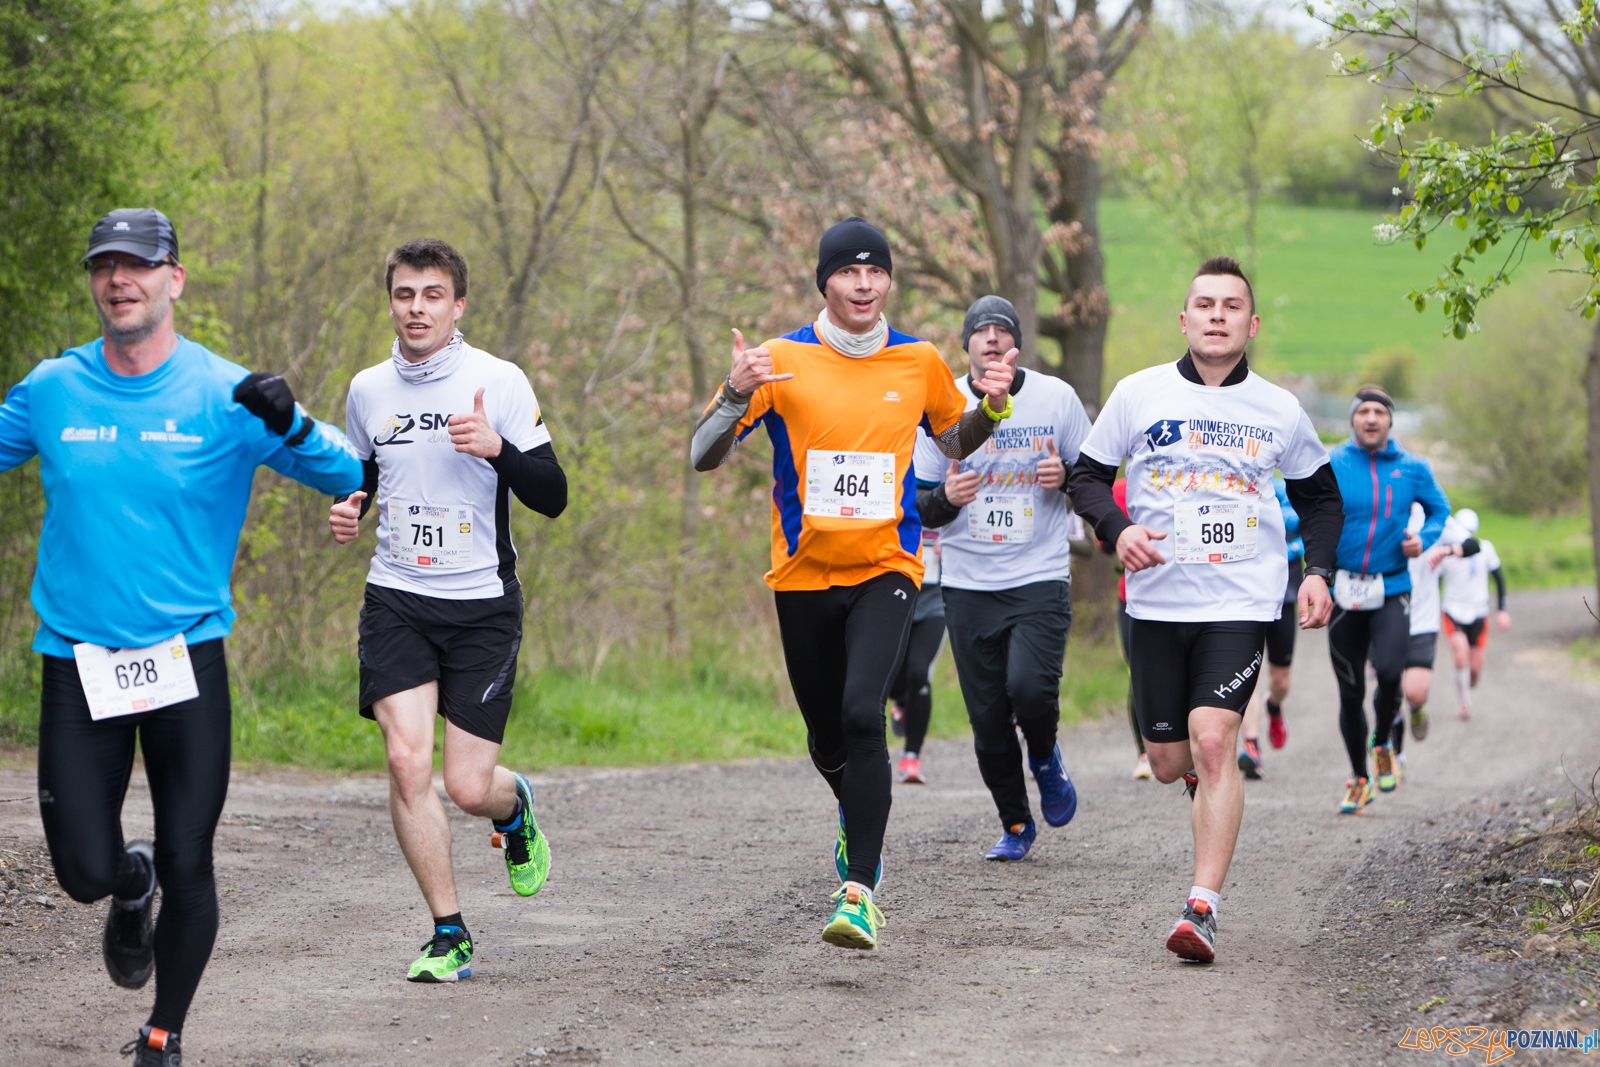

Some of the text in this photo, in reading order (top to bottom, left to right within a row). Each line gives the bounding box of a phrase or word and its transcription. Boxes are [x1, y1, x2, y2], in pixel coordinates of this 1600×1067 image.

[855, 251, 871, 260] 4F
[419, 412, 455, 430] SM
[427, 431, 453, 444] RUNN
[989, 425, 1055, 440] NIWERSYTECKA
[1189, 419, 1273, 444] UNIWERSYTECKA
[984, 437, 1031, 450] ZADYSZKA
[1032, 436, 1045, 452] IV
[1188, 431, 1244, 449] ZADYSZKA
[1245, 438, 1261, 458] IV
[833, 473, 870, 498] 464
[986, 510, 1013, 527] 476
[410, 523, 443, 548] 751
[1201, 522, 1235, 545] 589
[114, 658, 159, 690] 628
